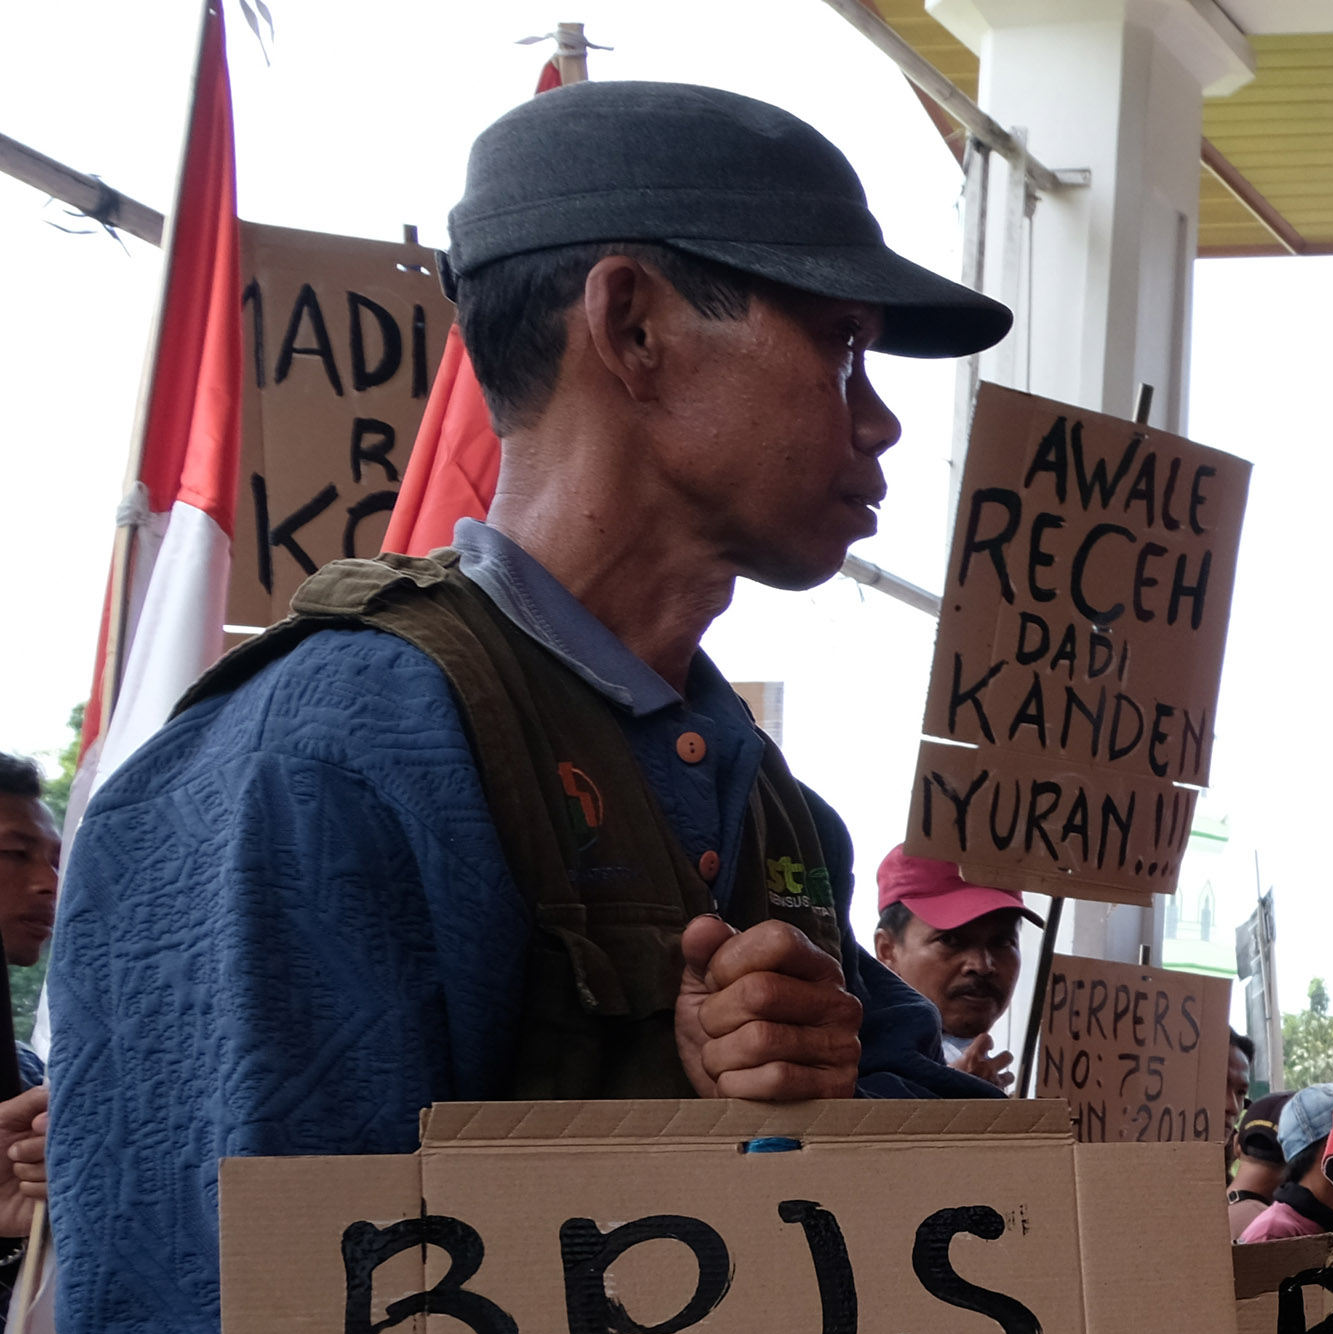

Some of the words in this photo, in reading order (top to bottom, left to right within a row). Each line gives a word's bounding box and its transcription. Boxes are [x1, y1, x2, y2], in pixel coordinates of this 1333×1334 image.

[1024, 416, 1216, 535] AWALE
[959, 487, 1212, 630] RECEH
[1016, 612, 1128, 682] DADI
[948, 653, 1206, 776] KANDEN
[1048, 973, 1200, 1053] PERPERS
[1118, 1053, 1165, 1101] 75
